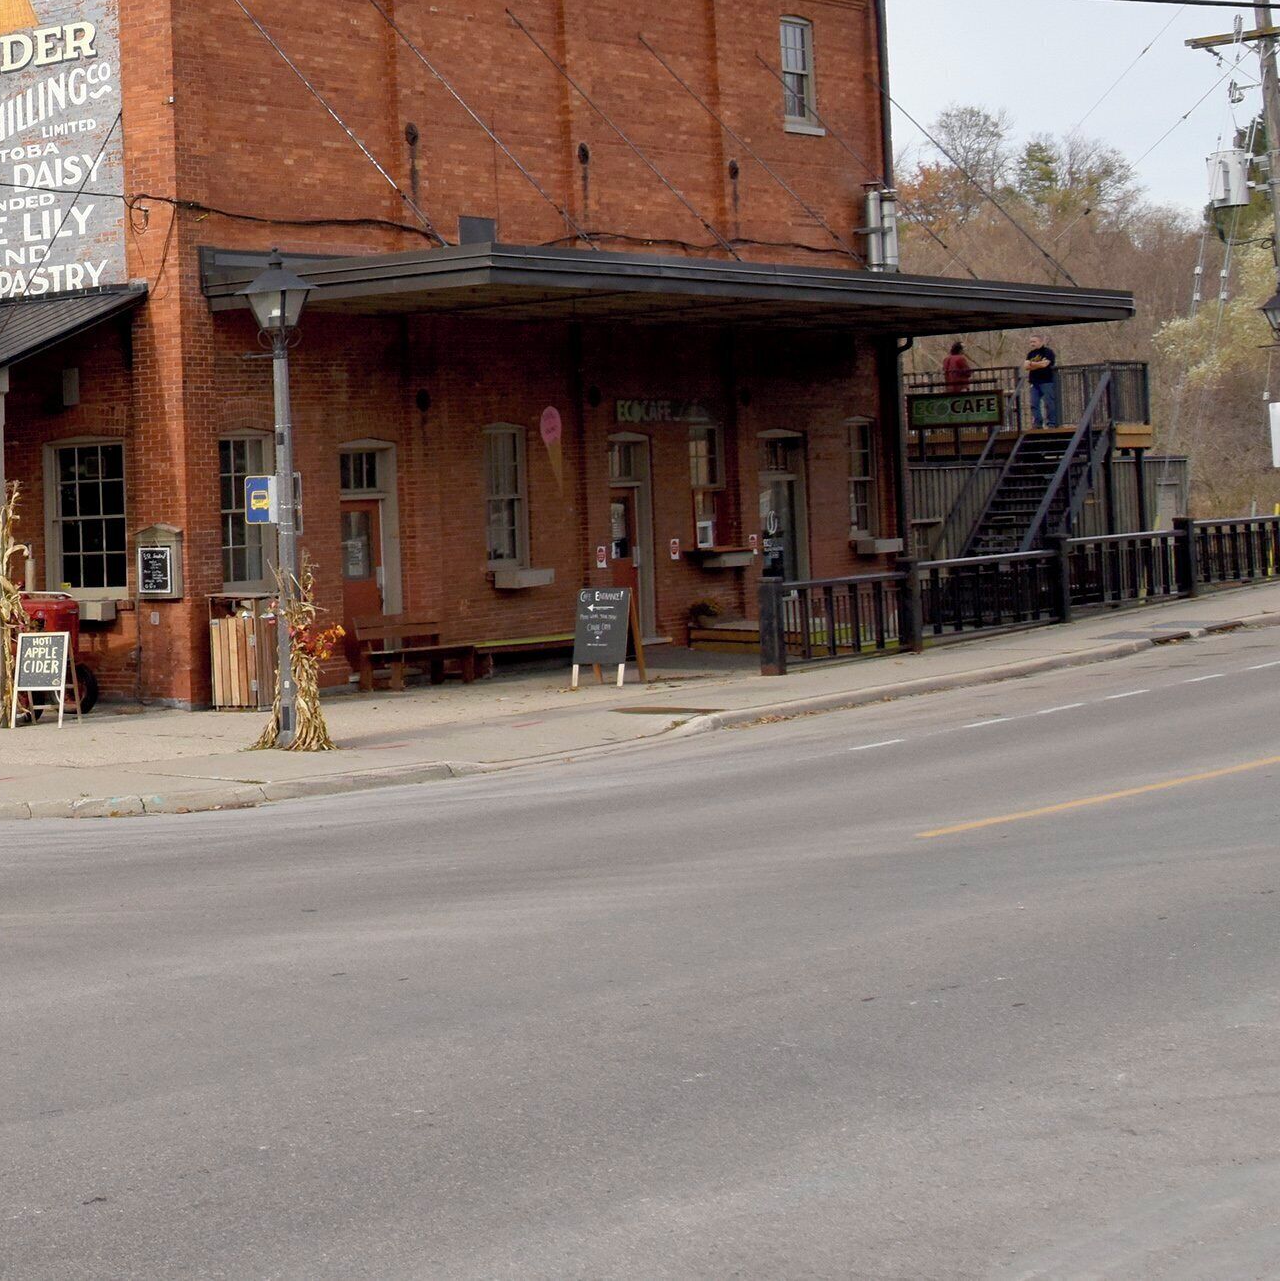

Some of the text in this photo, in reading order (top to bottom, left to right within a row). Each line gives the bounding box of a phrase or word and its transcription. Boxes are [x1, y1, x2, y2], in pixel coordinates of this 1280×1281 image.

[86, 62, 111, 84] CO
[42, 118, 97, 139] LIMITED
[13, 152, 106, 193] DAISY
[23, 204, 95, 242] LILY
[24, 647, 58, 659] APPLE
[23, 659, 60, 674] CIDER
